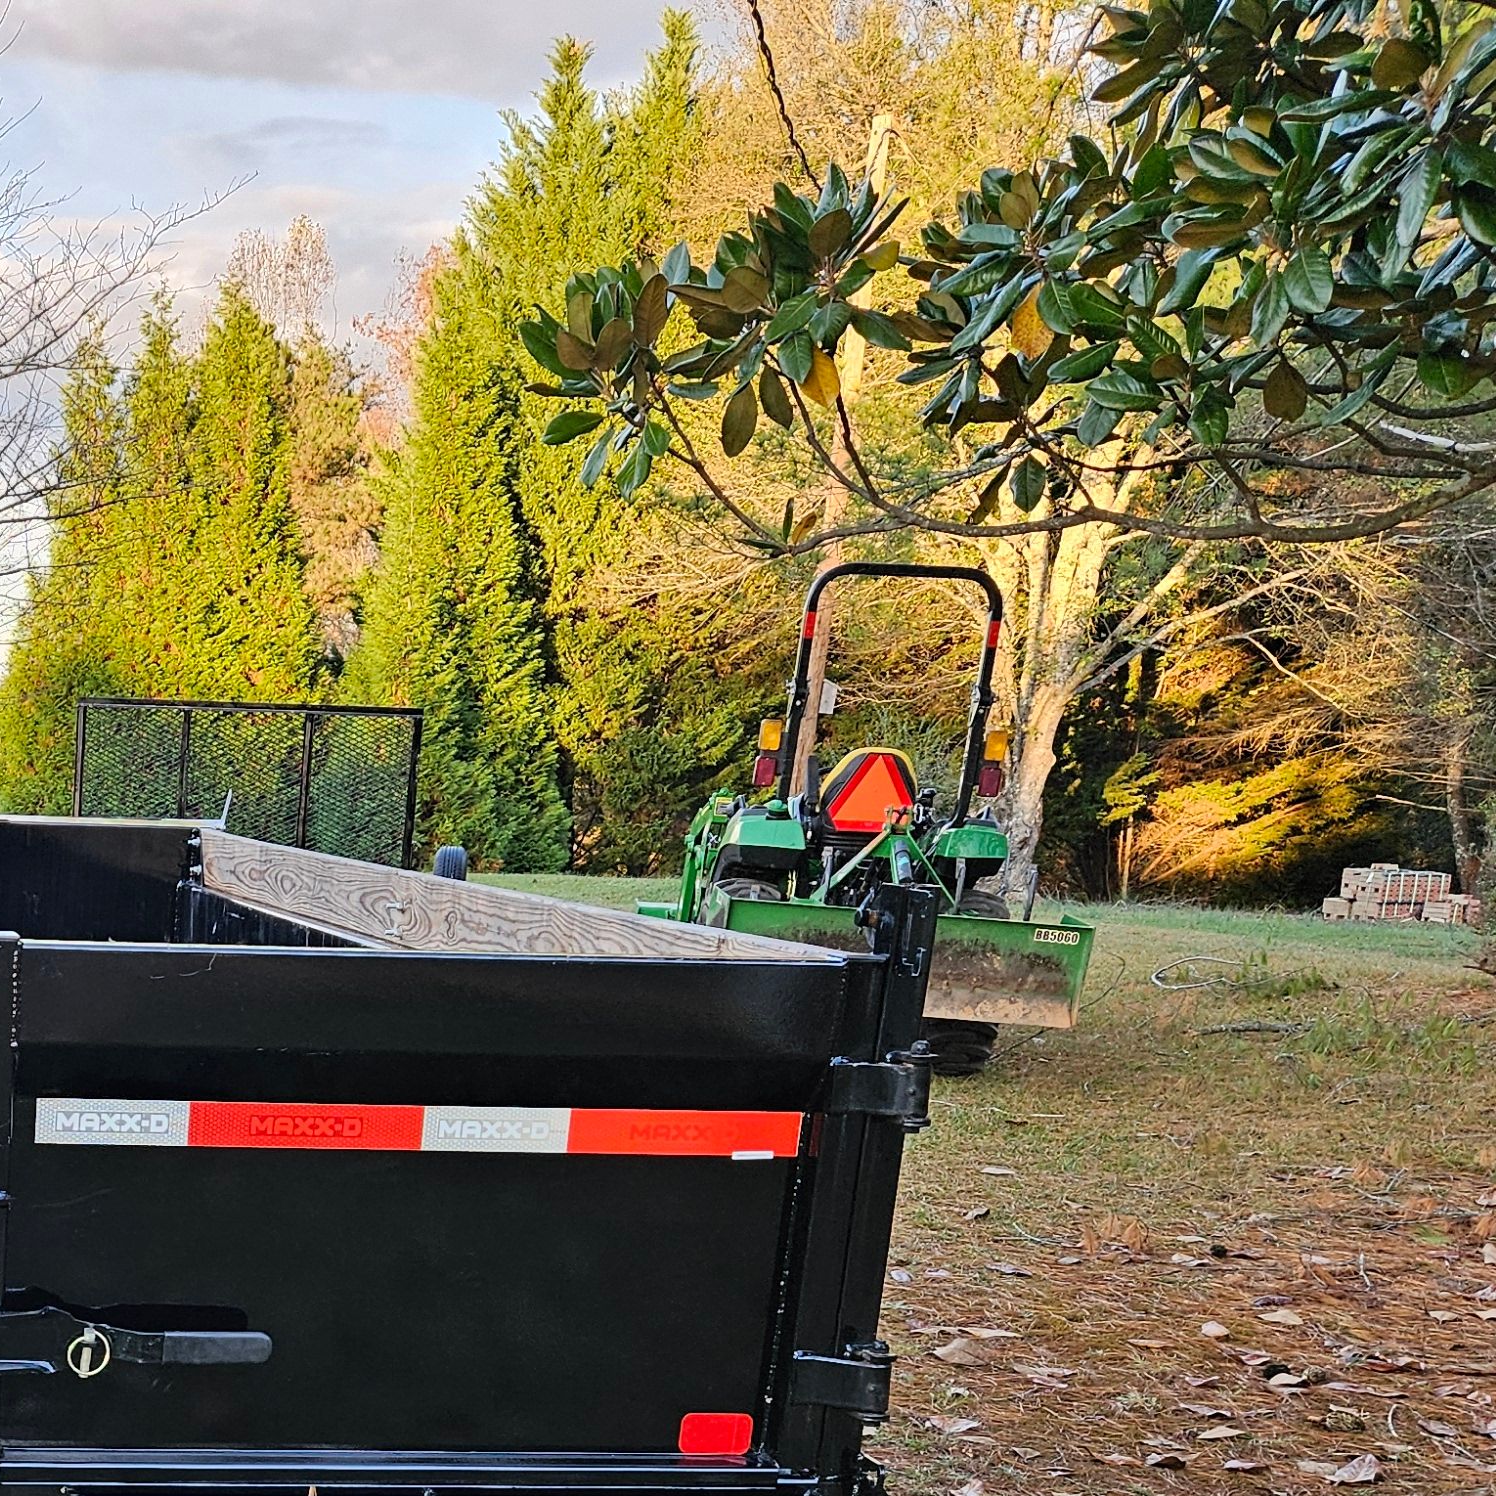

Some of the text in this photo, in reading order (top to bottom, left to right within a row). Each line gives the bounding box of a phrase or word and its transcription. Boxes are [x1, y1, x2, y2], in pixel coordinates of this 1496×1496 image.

[1035, 930, 1079, 944] BB5060
[55, 1111, 740, 1143] MAXX-D MAXX-D MAXX-D MAXX
